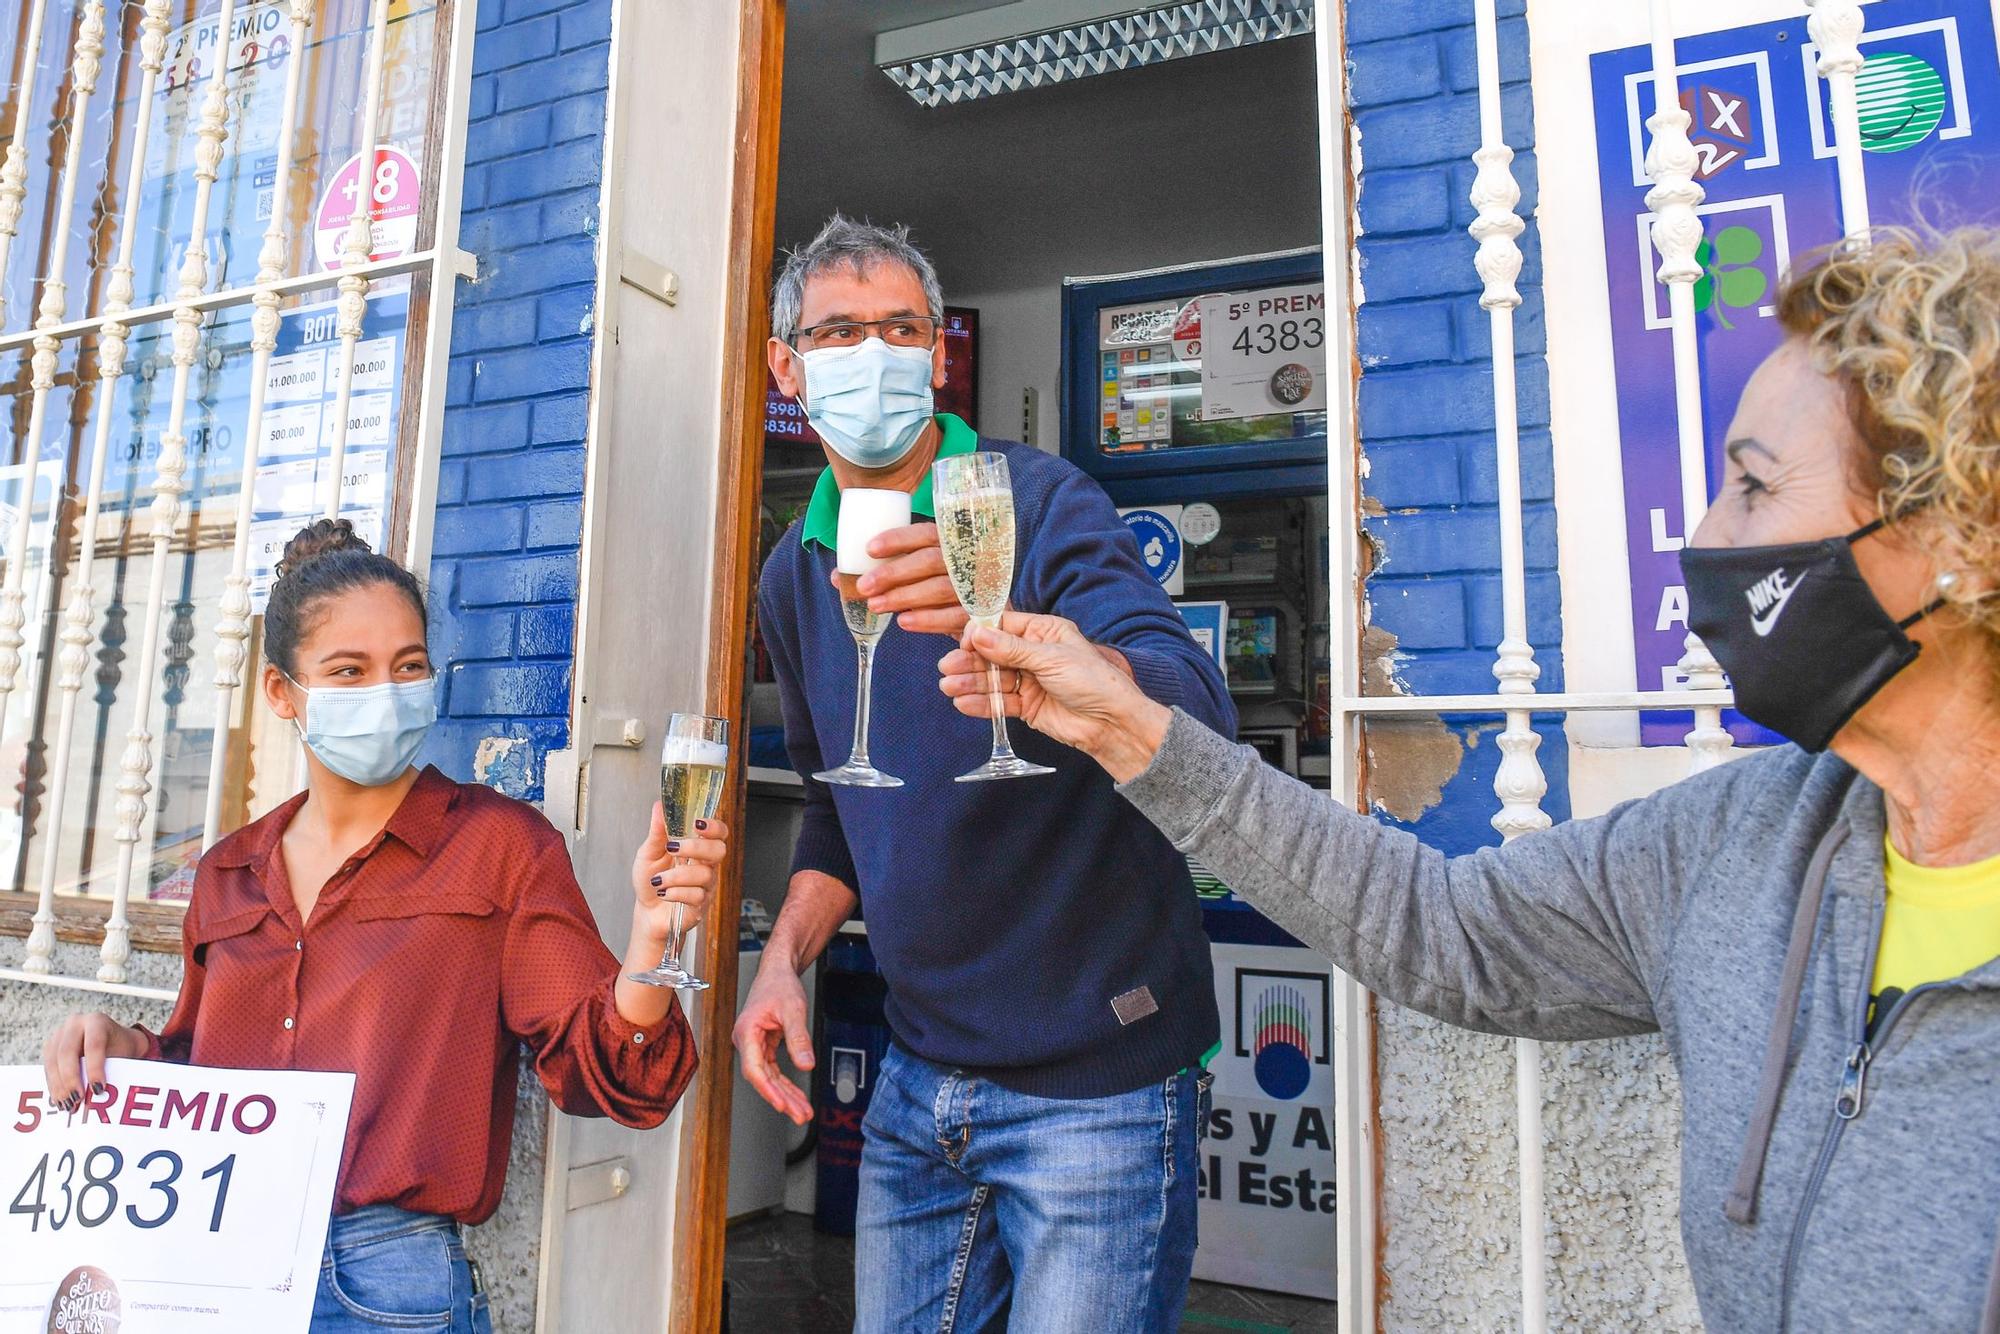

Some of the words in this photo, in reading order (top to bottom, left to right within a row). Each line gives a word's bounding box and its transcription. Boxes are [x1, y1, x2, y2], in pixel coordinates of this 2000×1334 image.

[1744, 567, 1790, 616] NIKE
[66, 1083, 277, 1135] REMIO
[1248, 1111, 1277, 1157] y
[9, 1145, 236, 1234] 43831
[56, 1290, 113, 1330] SORTEO
